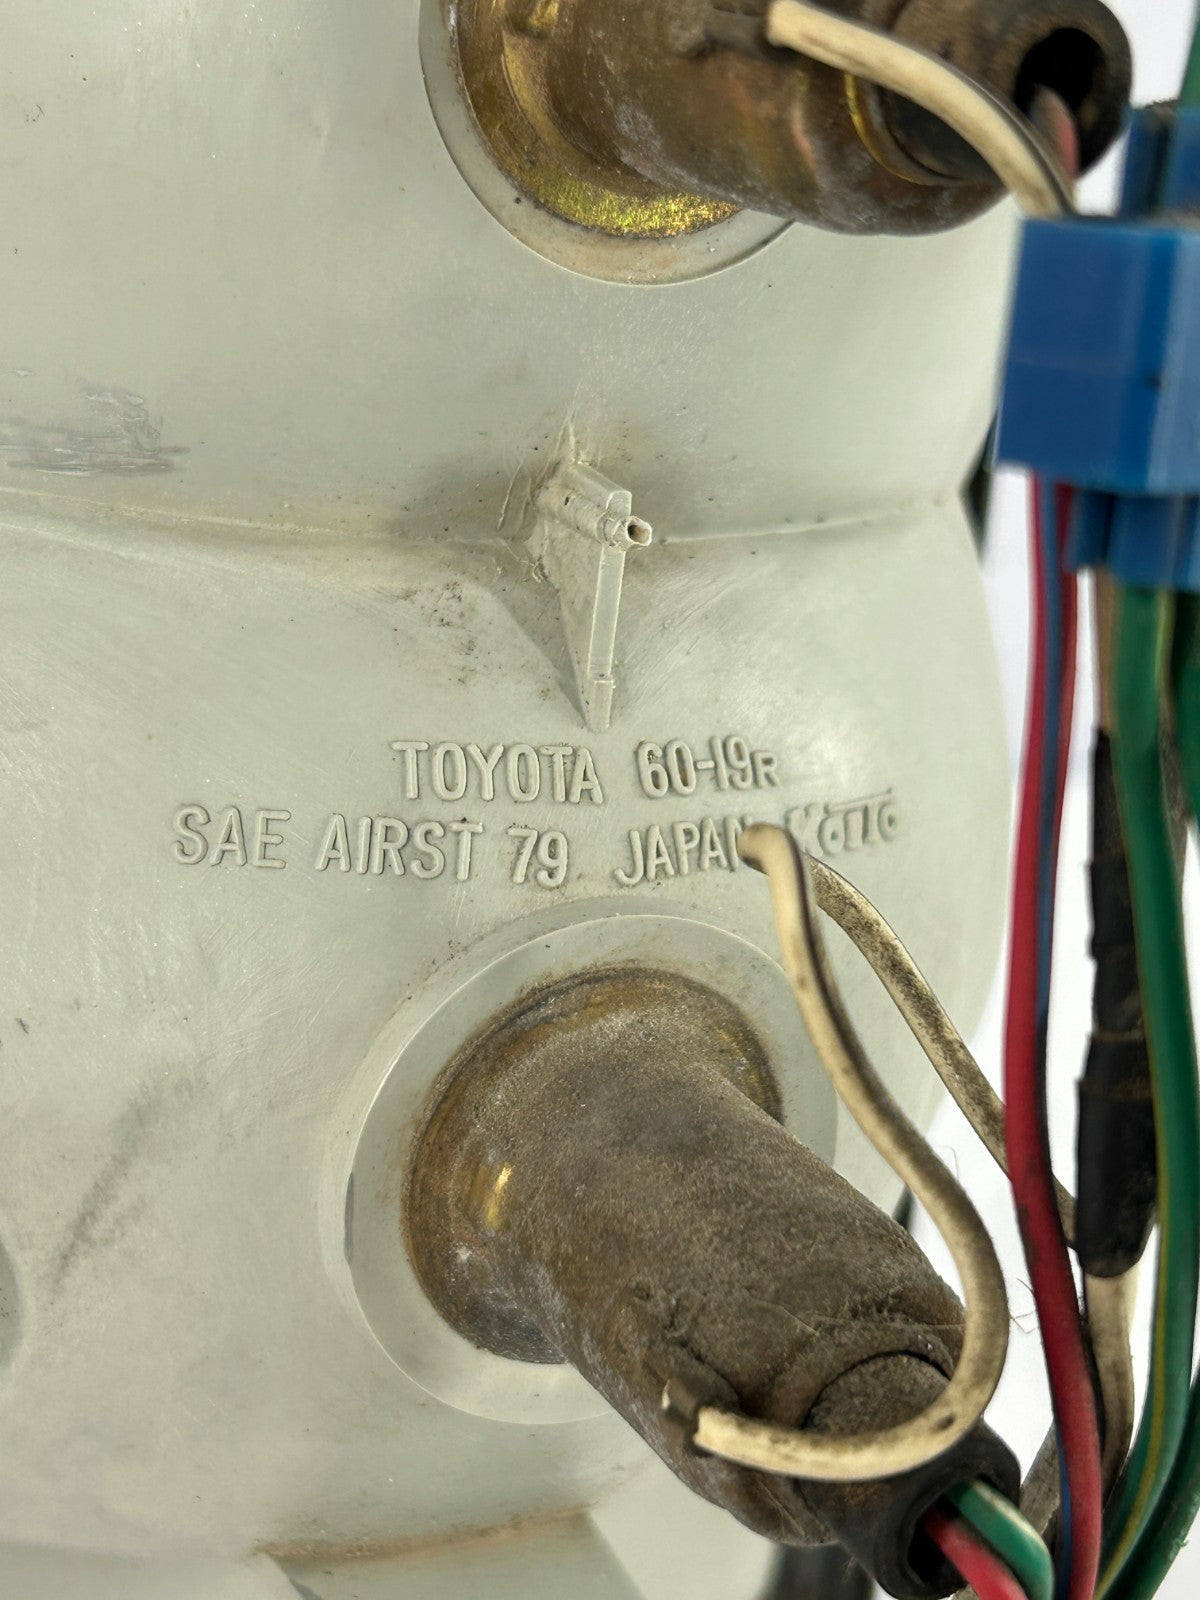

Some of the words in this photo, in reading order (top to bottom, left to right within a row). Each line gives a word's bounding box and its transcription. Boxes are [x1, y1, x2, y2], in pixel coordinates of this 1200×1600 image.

[391, 740, 604, 804] TOYOTA
[172, 804, 292, 870] SAE
[314, 813, 485, 880] AIRST
[507, 825, 569, 889] 79
